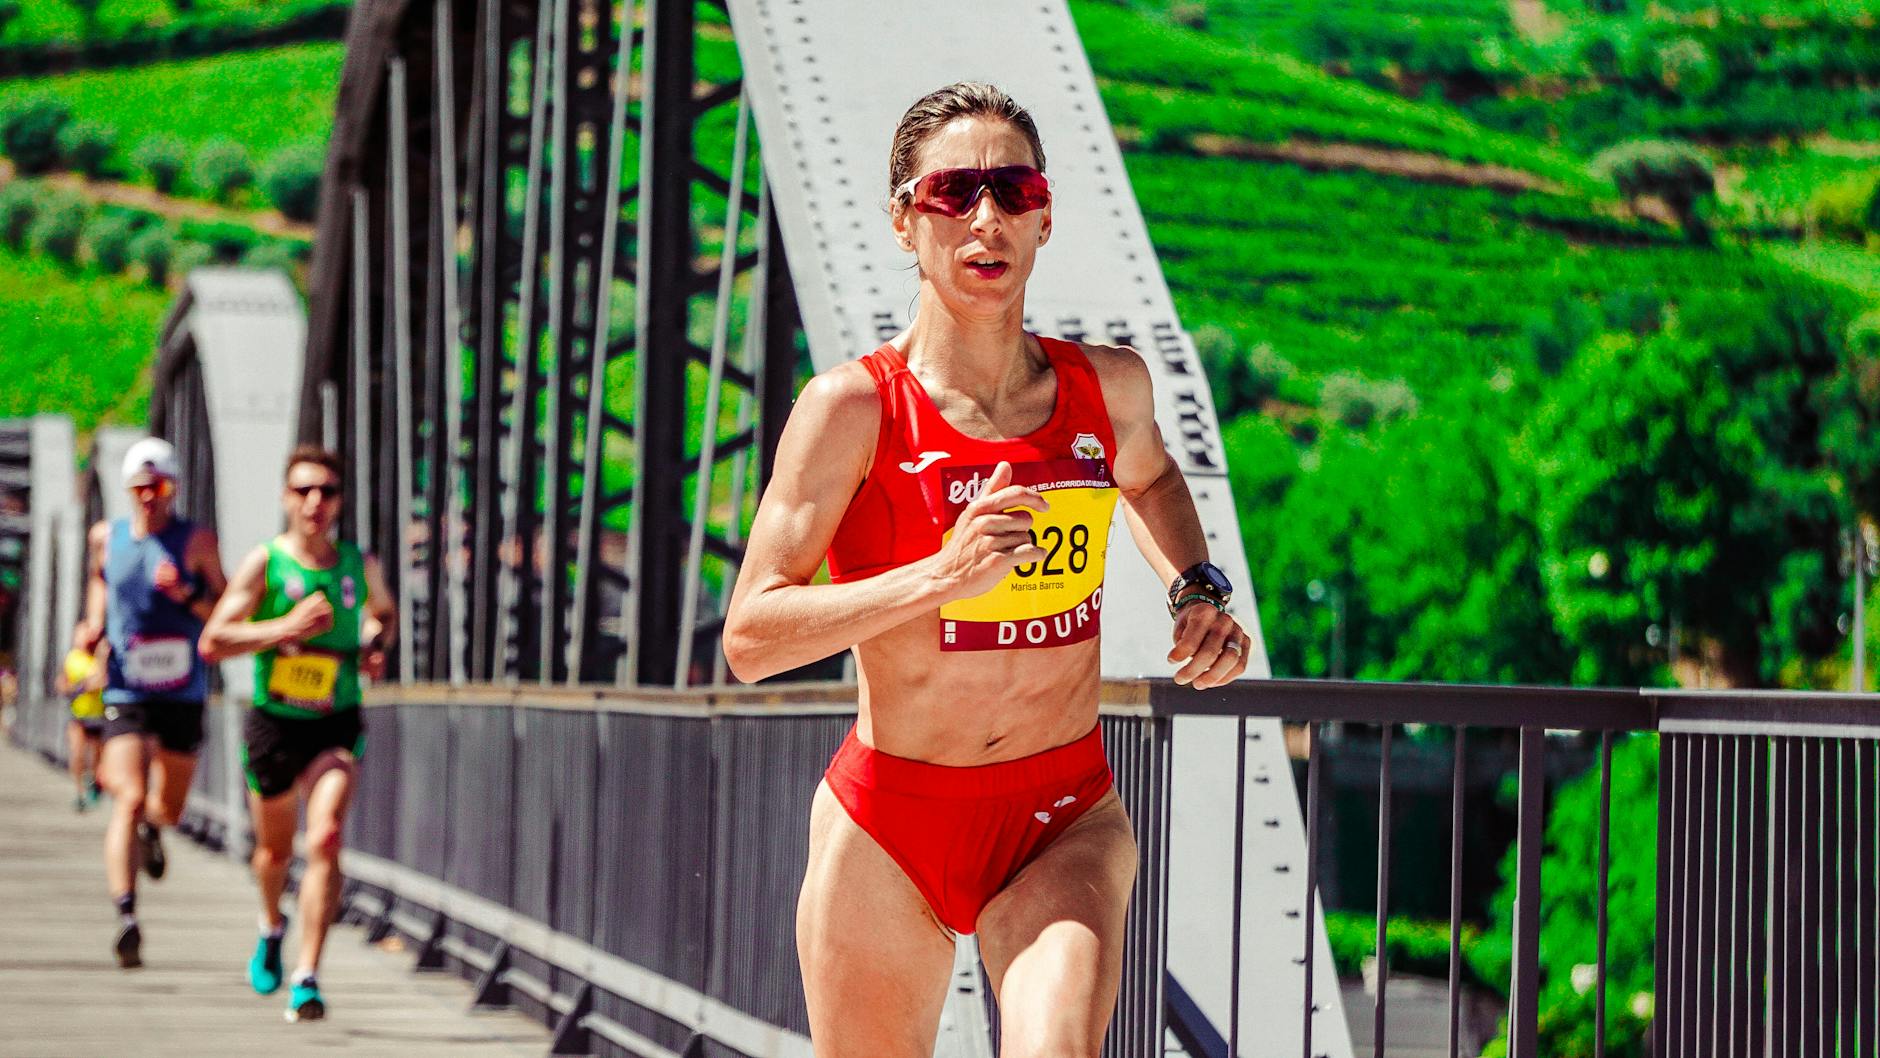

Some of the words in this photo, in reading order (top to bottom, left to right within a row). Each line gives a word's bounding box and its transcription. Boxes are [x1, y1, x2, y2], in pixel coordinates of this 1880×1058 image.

[948, 472, 987, 504] ed
[1038, 482, 1056, 491] BELA
[1056, 480, 1086, 489] CORRIDA
[1011, 582, 1037, 592] Marisa
[1039, 581, 1065, 591] Barros
[998, 587, 1103, 645] DOURO
